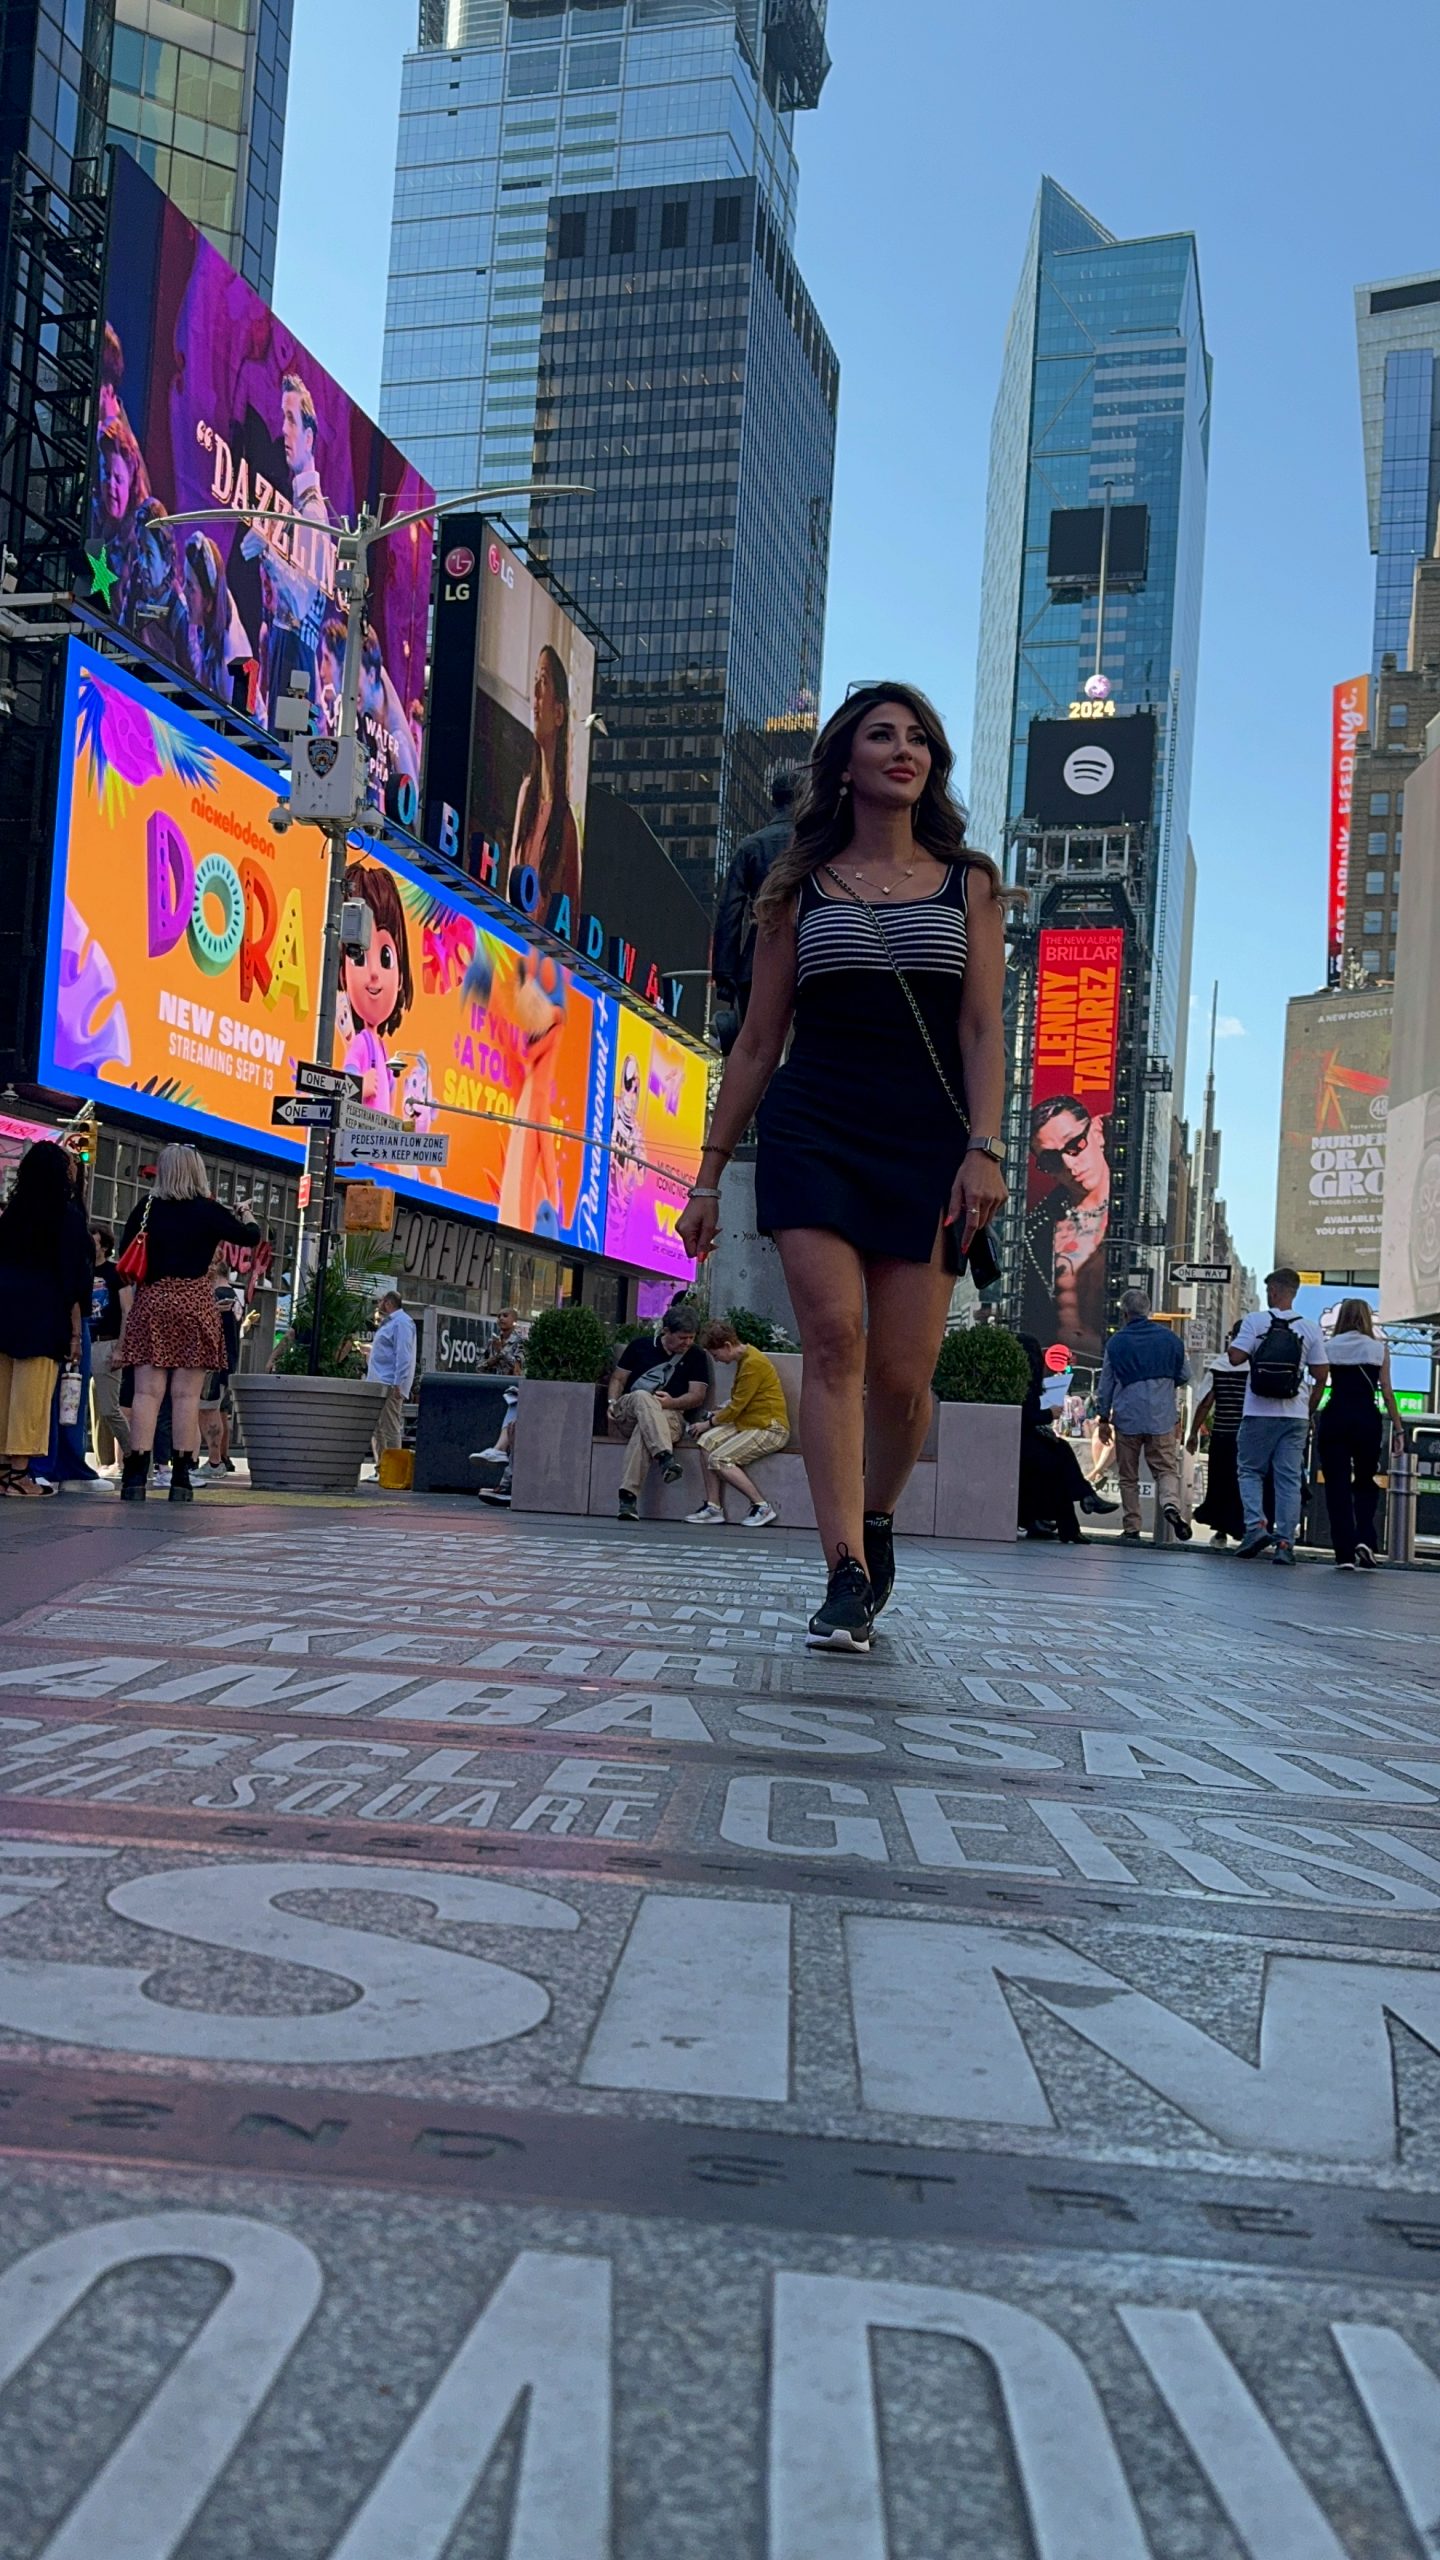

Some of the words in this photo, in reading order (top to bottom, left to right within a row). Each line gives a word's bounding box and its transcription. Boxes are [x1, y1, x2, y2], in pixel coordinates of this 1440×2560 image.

[500, 558, 514, 589] LG
[445, 584, 470, 601] LG
[1068, 700, 1115, 719] 2024
[190, 794, 276, 860] nickelodeon
[147, 809, 309, 1023] DORA
[1045, 936, 1063, 945] THE
[1064, 936, 1086, 945] NEW
[1087, 934, 1121, 945] ALBUM
[1046, 946, 1118, 961] BRILLAR
[158, 990, 215, 1040] NEW
[217, 1014, 287, 1067] SHOW
[1038, 969, 1079, 1067] LENNY
[1073, 965, 1117, 1095] TAVAREZ
[1326, 1012, 1347, 1022] NEW
[1347, 1007, 1389, 1020] PODCAST
[168, 1030, 234, 1078] STREAMING
[235, 1055, 262, 1086] SEPT
[262, 1066, 274, 1093] 13
[306, 1072, 327, 1088] ONE
[334, 1078, 354, 1095] WAY
[443, 1067, 482, 1113] SAY
[285, 1105, 308, 1118] ONE
[346, 1104, 375, 1123] PEDESTRIAN
[351, 1134, 399, 1147] PEDESTRIAN
[400, 1136, 422, 1148] FLOW
[423, 1137, 444, 1149] ZONE
[391, 1149, 411, 1161] KEEP
[412, 1150, 443, 1162] MOVING
[1315, 1227, 1336, 1236] YOU
[1337, 1226, 1356, 1235] GET
[1323, 1214, 1376, 1225] AVAILABLE
[391, 1207, 496, 1291] FOREVER
[1178, 1269, 1197, 1278] ONE
[1204, 1269, 1224, 1278] WAY
[289, 1581, 810, 1626] FONTANN
[308, 1600, 811, 1643] BARRYMOR
[78, 1594, 797, 1653] LONGACR
[185, 1621, 738, 1686] KERR
[192, 1772, 656, 1842] SQUARE
[213, 1824, 521, 1857] 51ST
[602, 1854, 1140, 1913] STREET
